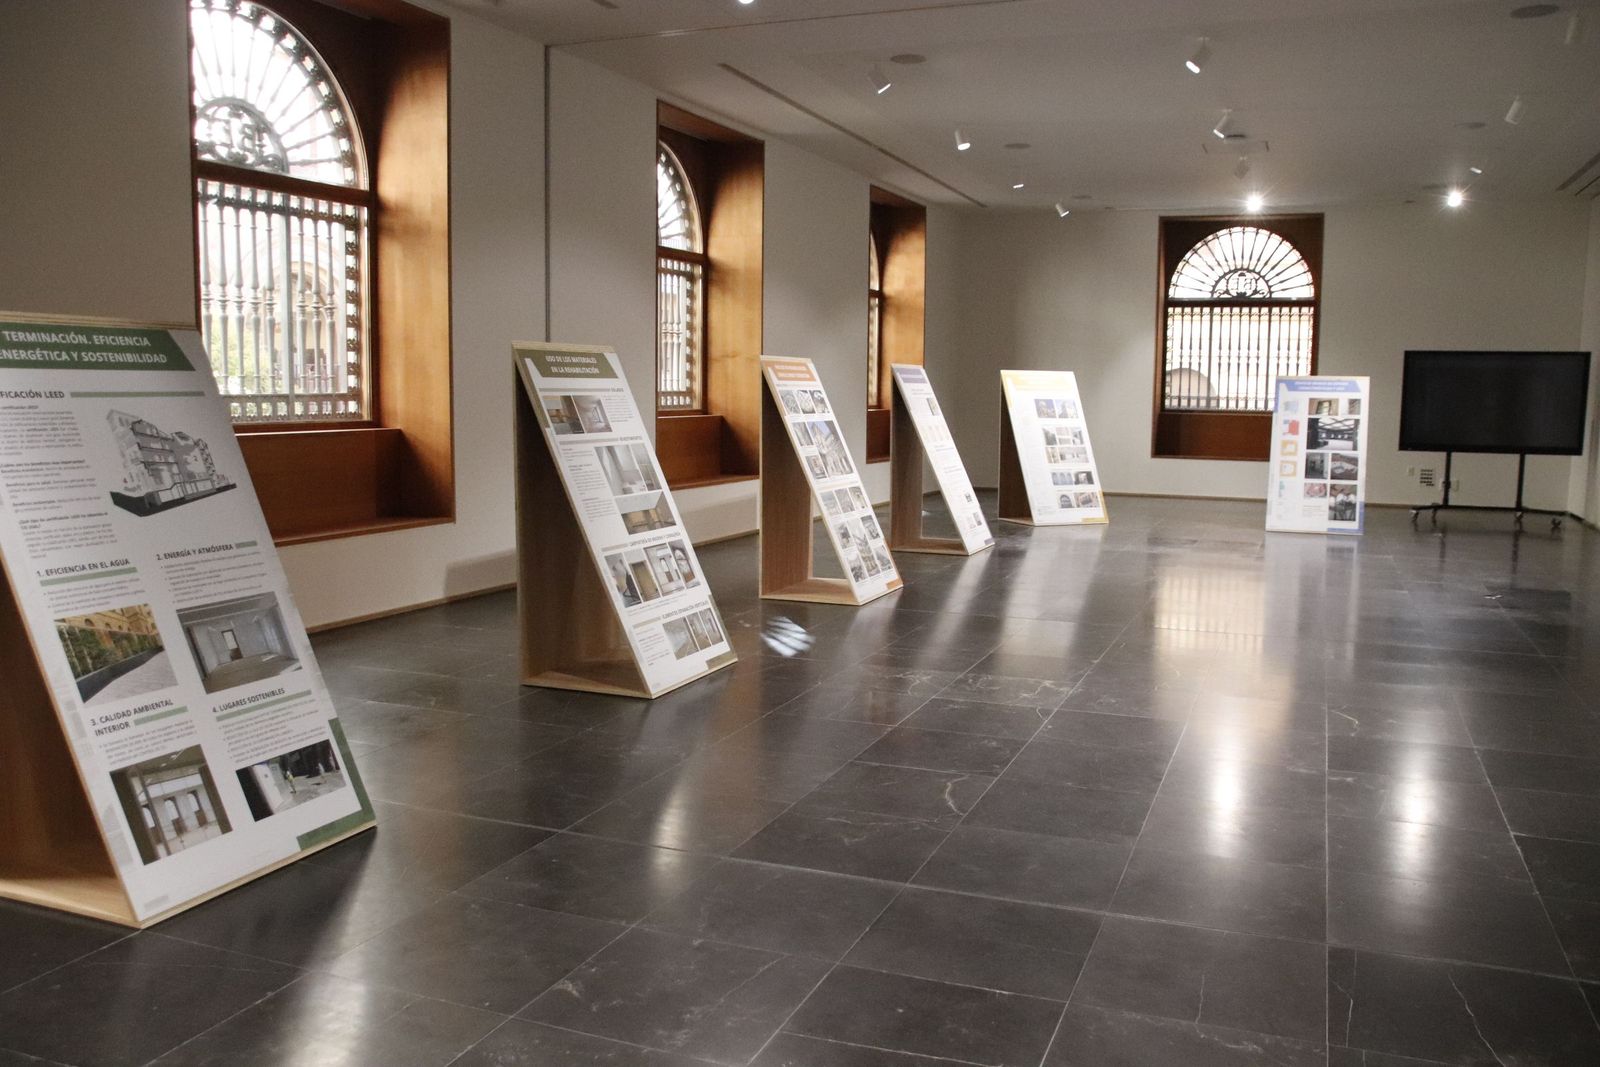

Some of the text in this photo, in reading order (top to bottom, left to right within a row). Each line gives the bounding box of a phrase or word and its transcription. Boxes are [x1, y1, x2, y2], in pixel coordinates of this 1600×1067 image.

[2, 330, 151, 347] TERMINACIÓN. EFICIENCIA
[71, 351, 79, 361] Y
[82, 351, 168, 364] SOSTENIBILIDAD
[44, 390, 65, 399] LEED
[163, 548, 191, 560] ENERGÍA
[198, 544, 234, 555] ATMÓSFERA
[45, 564, 87, 577] EFICIENCIA
[89, 563, 99, 571] EN
[110, 558, 130, 567] AGUA
[218, 697, 247, 712] LUGARES
[247, 687, 286, 704] SOSTENIBLES
[99, 710, 132, 724] CALIDAD
[133, 698, 174, 716] AMBIENTAL
[94, 721, 131, 737] INTERIOR
